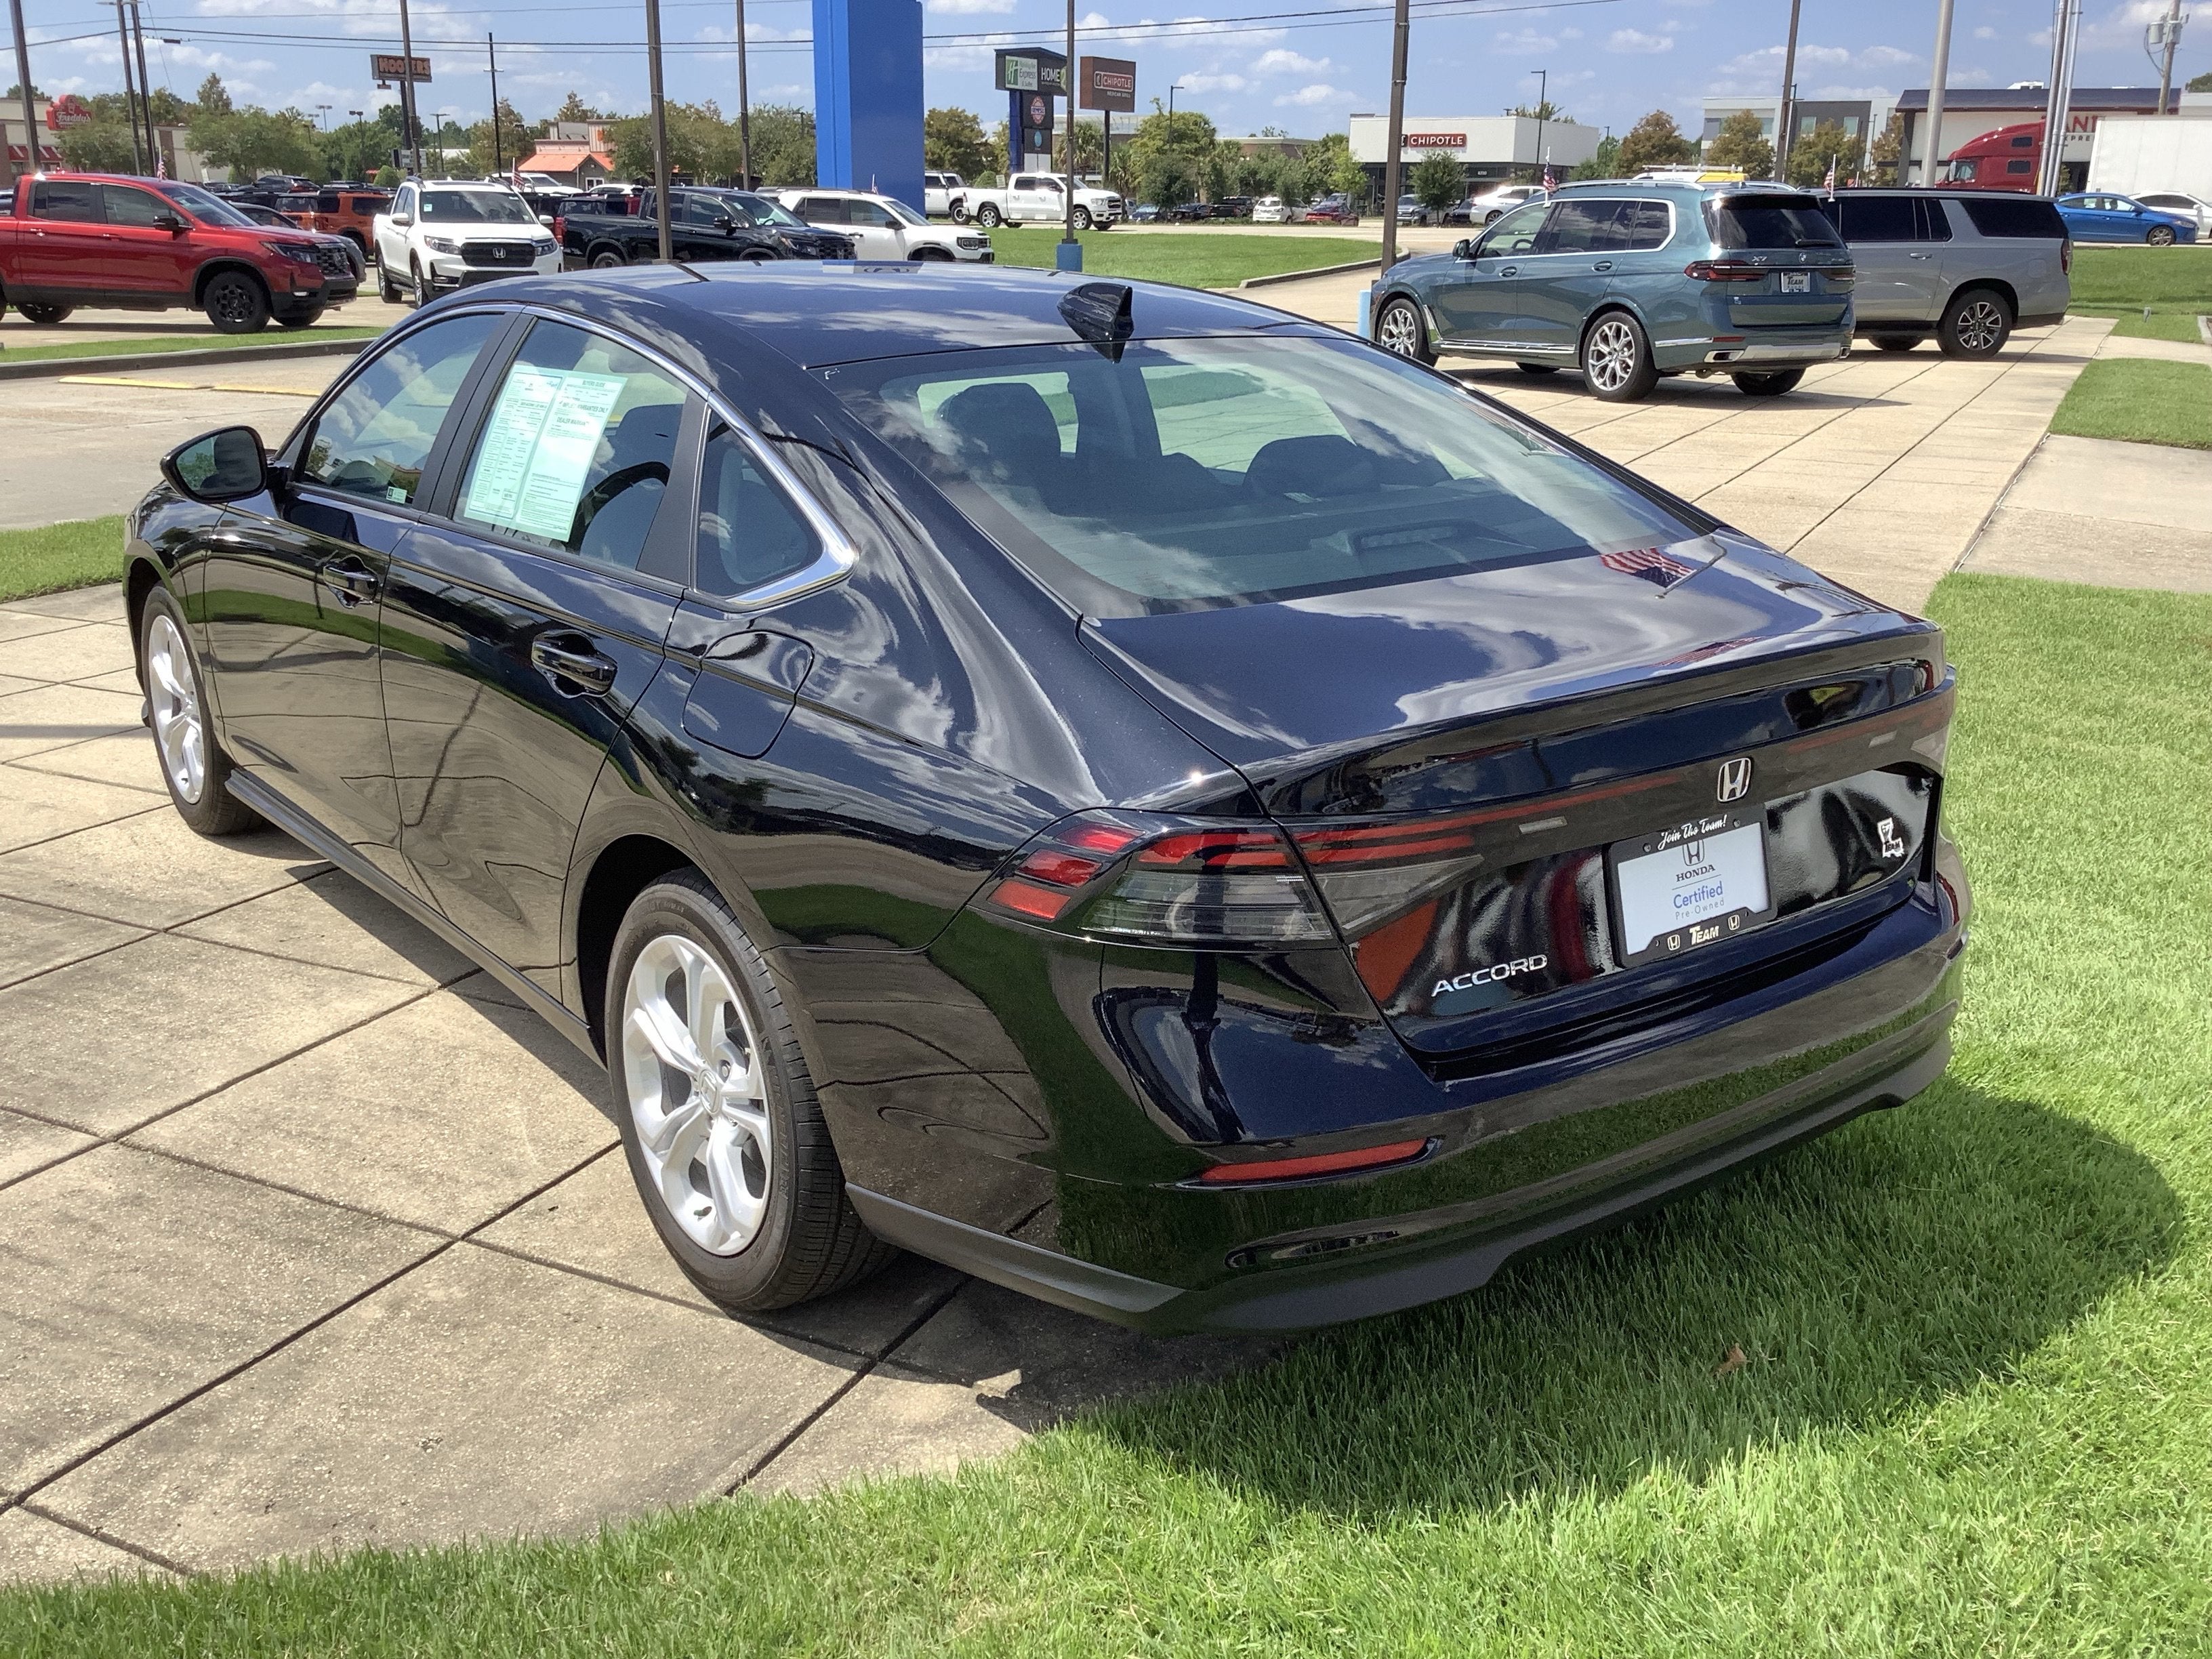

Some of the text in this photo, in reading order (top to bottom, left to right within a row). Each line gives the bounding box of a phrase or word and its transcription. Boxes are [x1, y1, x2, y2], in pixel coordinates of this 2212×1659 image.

[378, 58, 430, 75] HOOERS
[1041, 66, 1061, 82] HOME
[1103, 76, 1132, 89] CHIPOTLE
[1410, 136, 1464, 146] CHIPOTLE
[1658, 814, 1727, 851] Join The Team!
[1676, 864, 1716, 882] HONDA
[1673, 880, 1723, 909] Certified
[1675, 897, 1725, 920] Pre-Owned
[1689, 925, 1720, 946] TEAM
[1431, 954, 1549, 998] ACCORD
